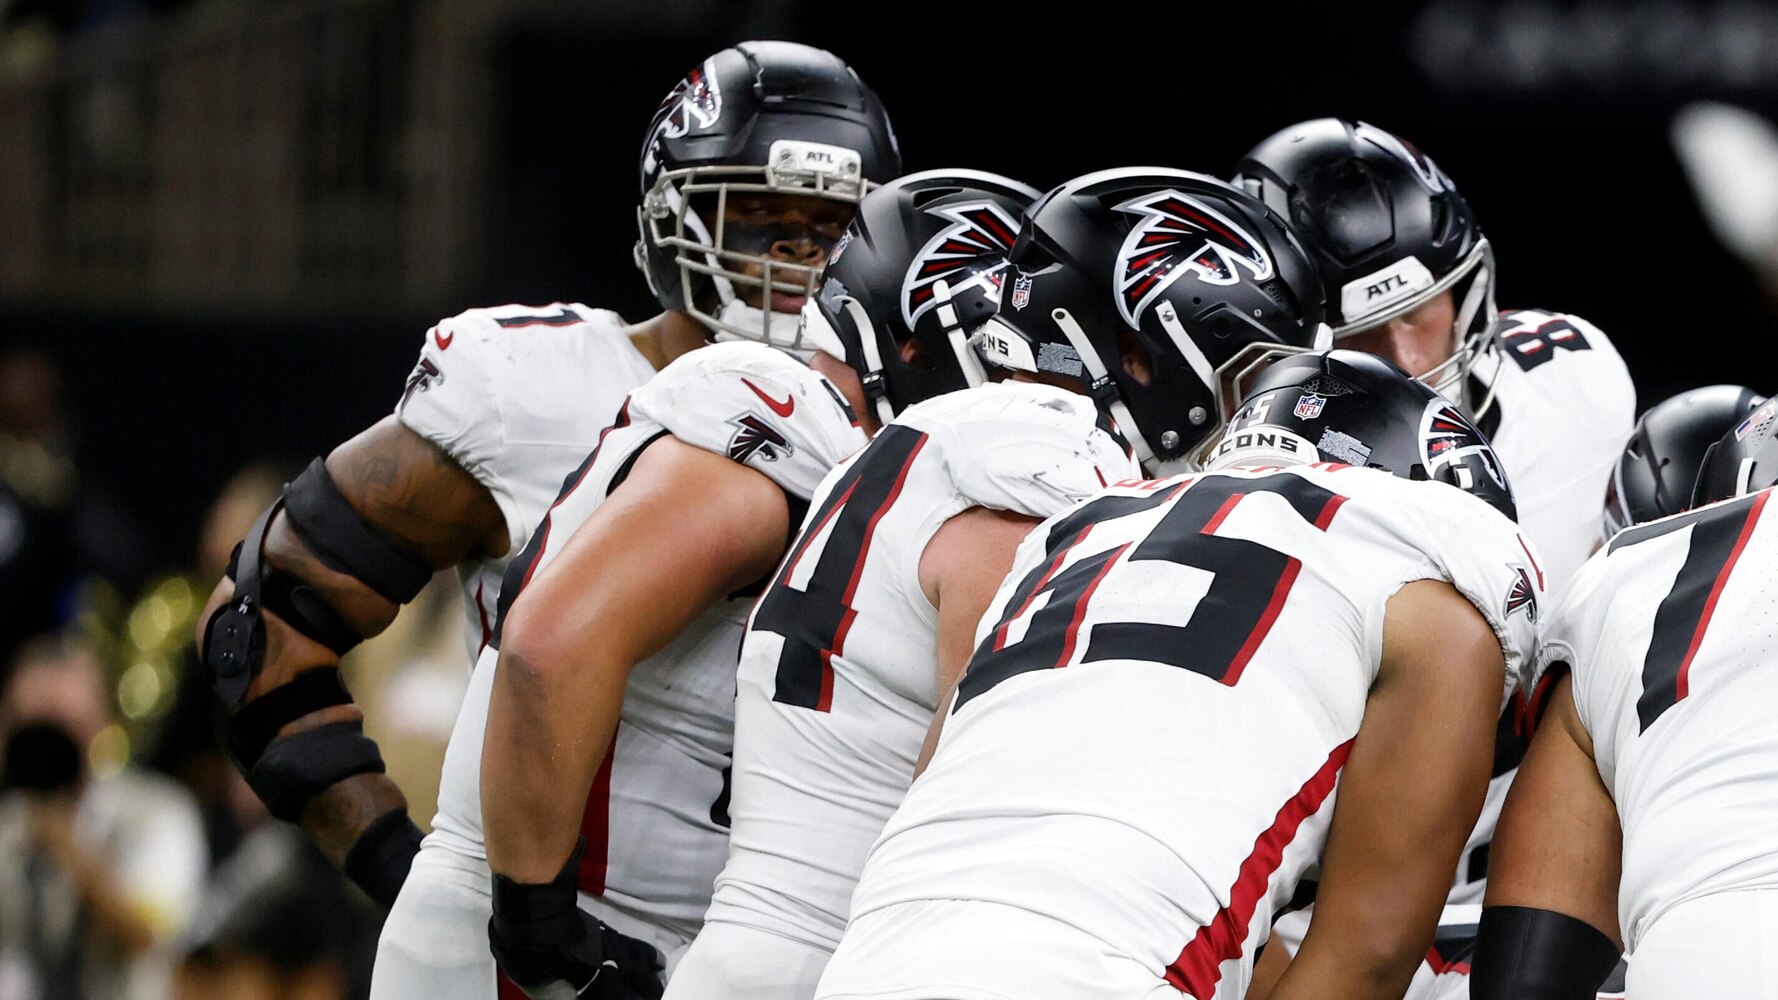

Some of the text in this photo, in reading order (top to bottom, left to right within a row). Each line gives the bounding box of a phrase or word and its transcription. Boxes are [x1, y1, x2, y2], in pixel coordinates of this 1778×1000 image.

[806, 151, 834, 164] ATL
[1366, 274, 1408, 300] ATL
[1498, 308, 1592, 373] 8
[1203, 433, 1298, 466] LCONS
[953, 473, 1350, 715] 65
